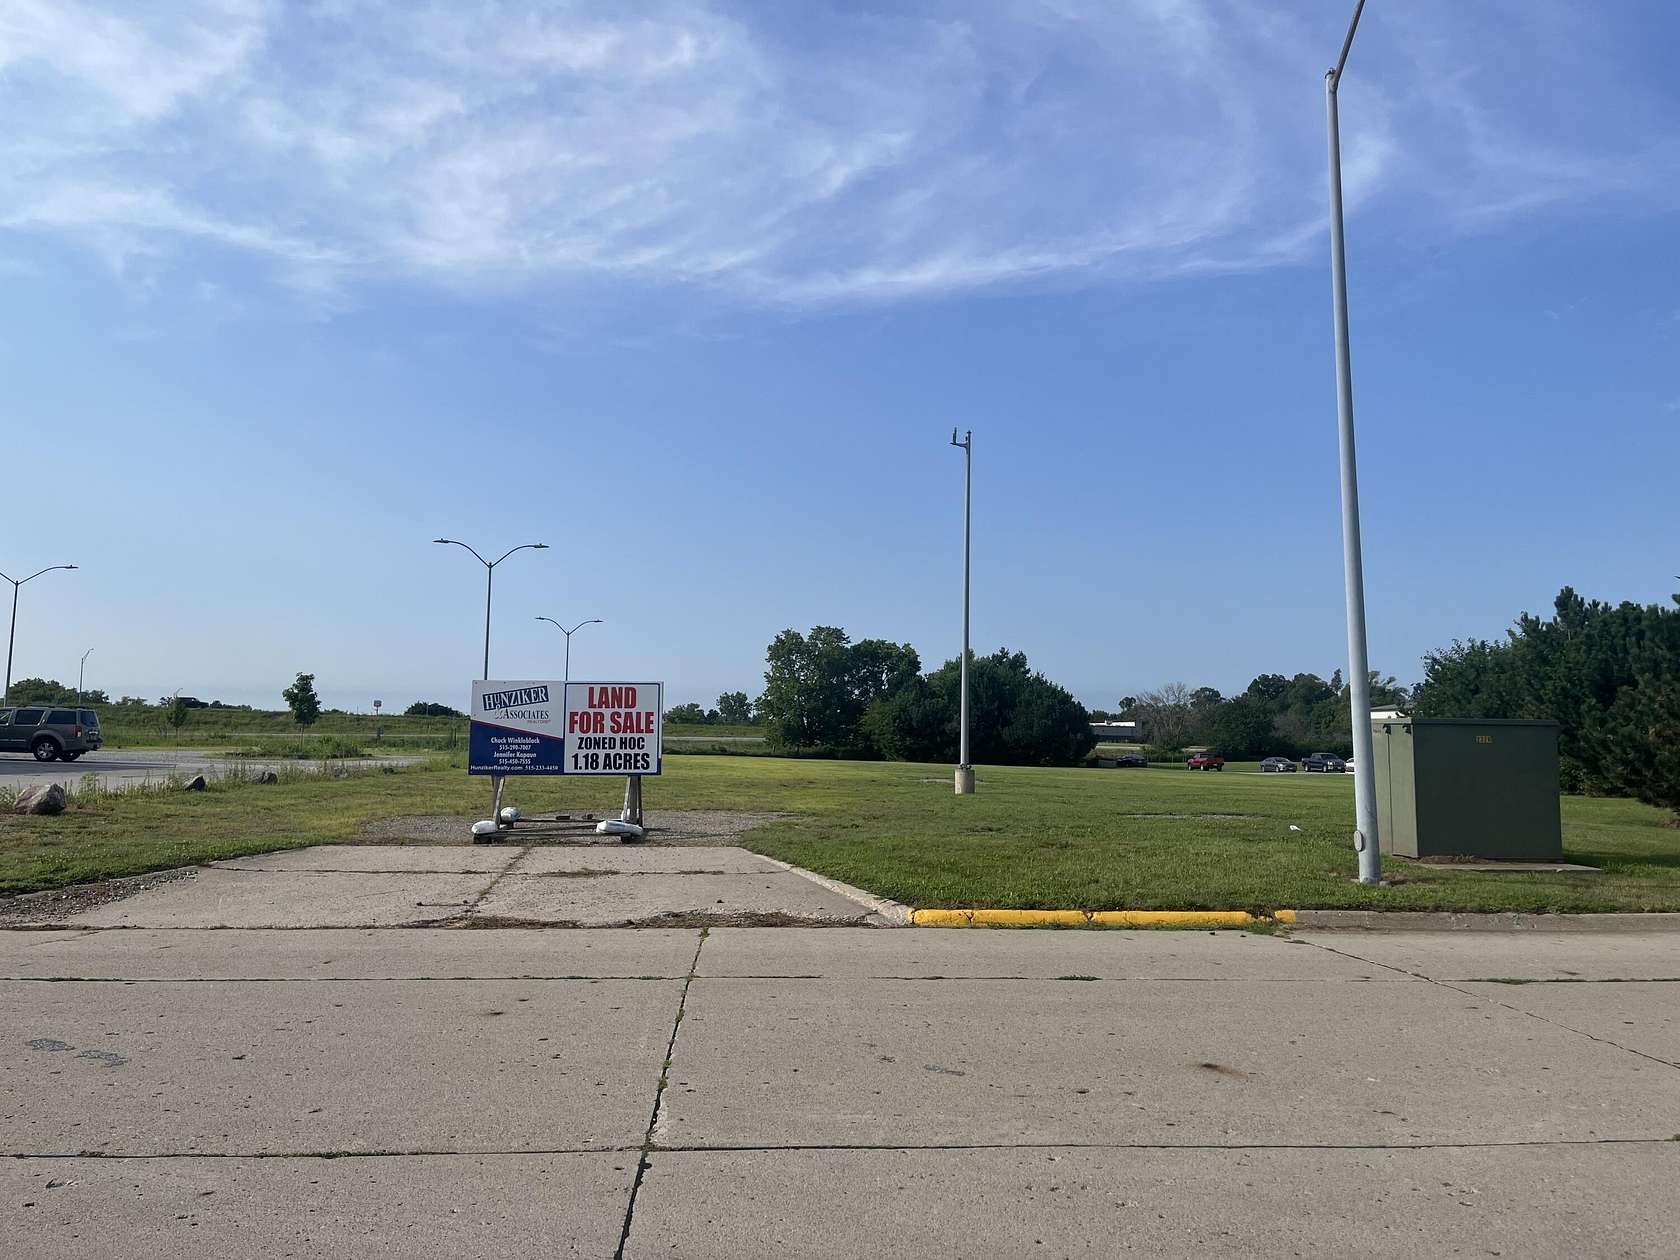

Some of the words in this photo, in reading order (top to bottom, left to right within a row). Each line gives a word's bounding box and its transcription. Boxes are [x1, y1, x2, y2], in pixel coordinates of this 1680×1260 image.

[484, 687, 548, 710] HUNZIKER
[588, 687, 636, 709] LAND
[569, 711, 605, 734] FOR
[610, 711, 654, 734] SALE
[577, 737, 616, 750] ZONED
[619, 737, 645, 750] HOC
[572, 753, 599, 770] 1.18
[603, 753, 650, 771] ACRES
